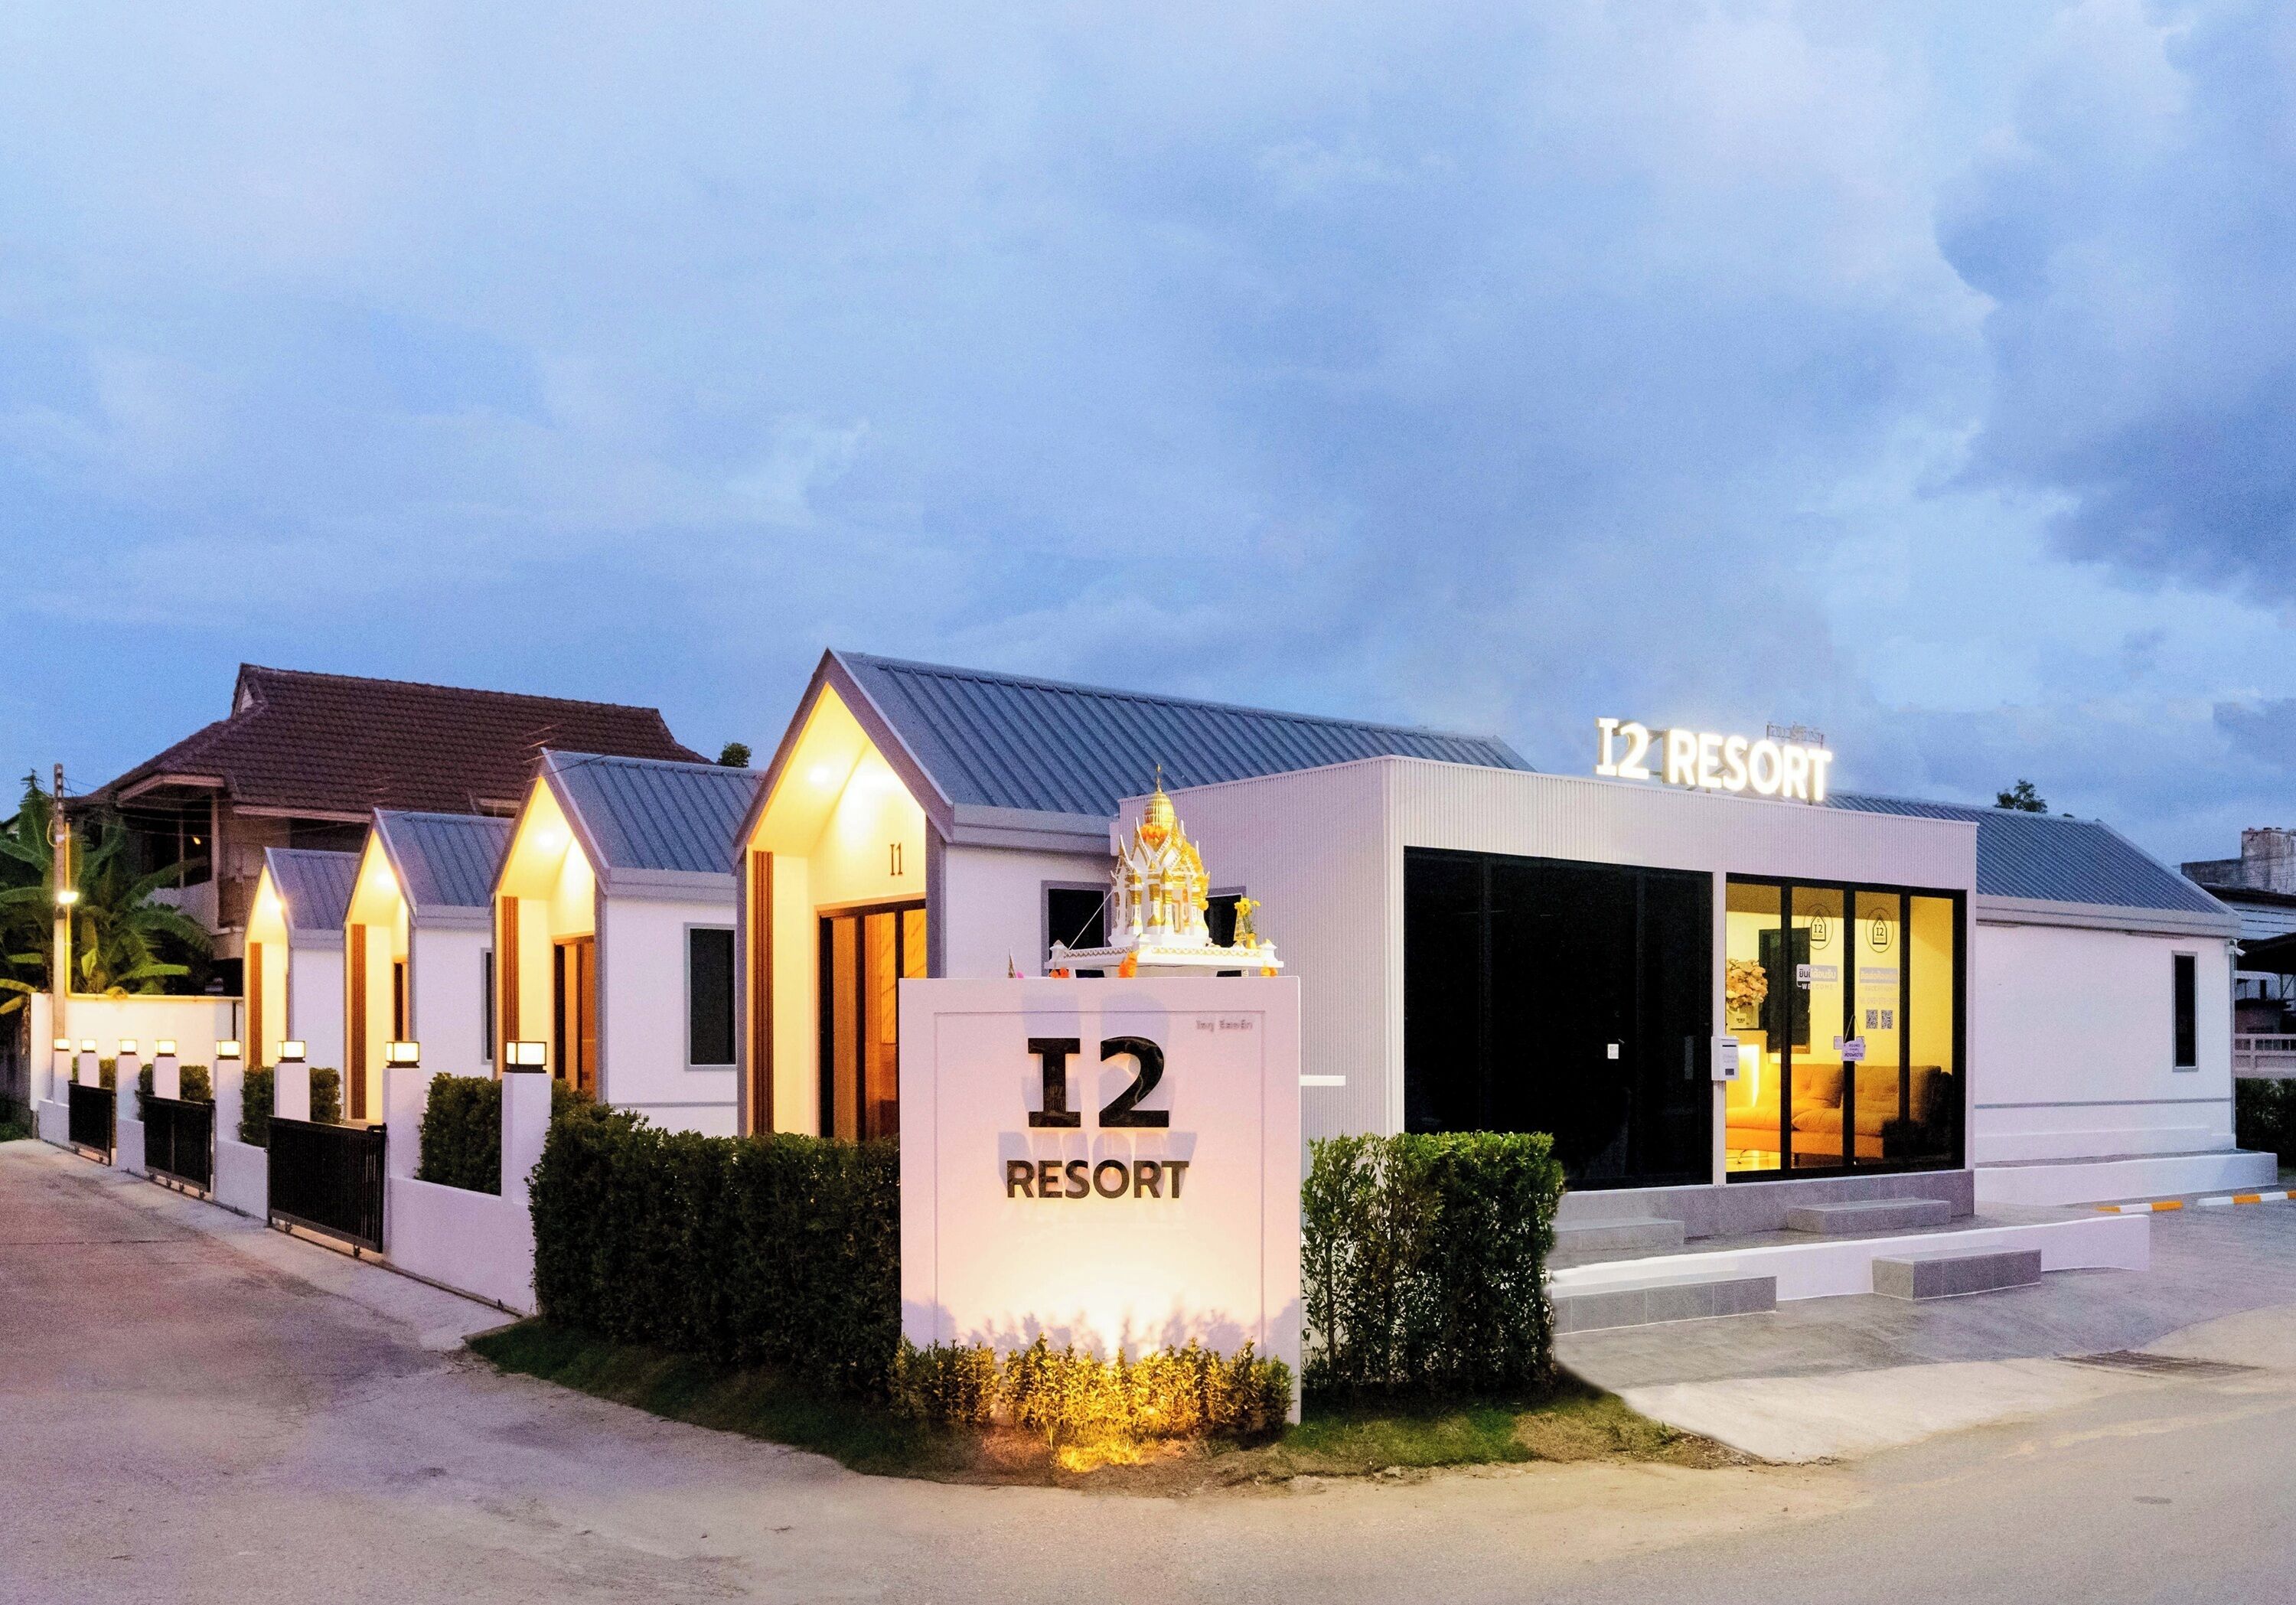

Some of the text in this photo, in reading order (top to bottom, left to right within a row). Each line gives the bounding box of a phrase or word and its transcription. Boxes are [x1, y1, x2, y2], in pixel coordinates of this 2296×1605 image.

[1596, 717, 1833, 801] I2 RESORT
[889, 843, 903, 876] I1
[1028, 1036, 1170, 1128] I2
[1007, 1160, 1189, 1199] RESORT
